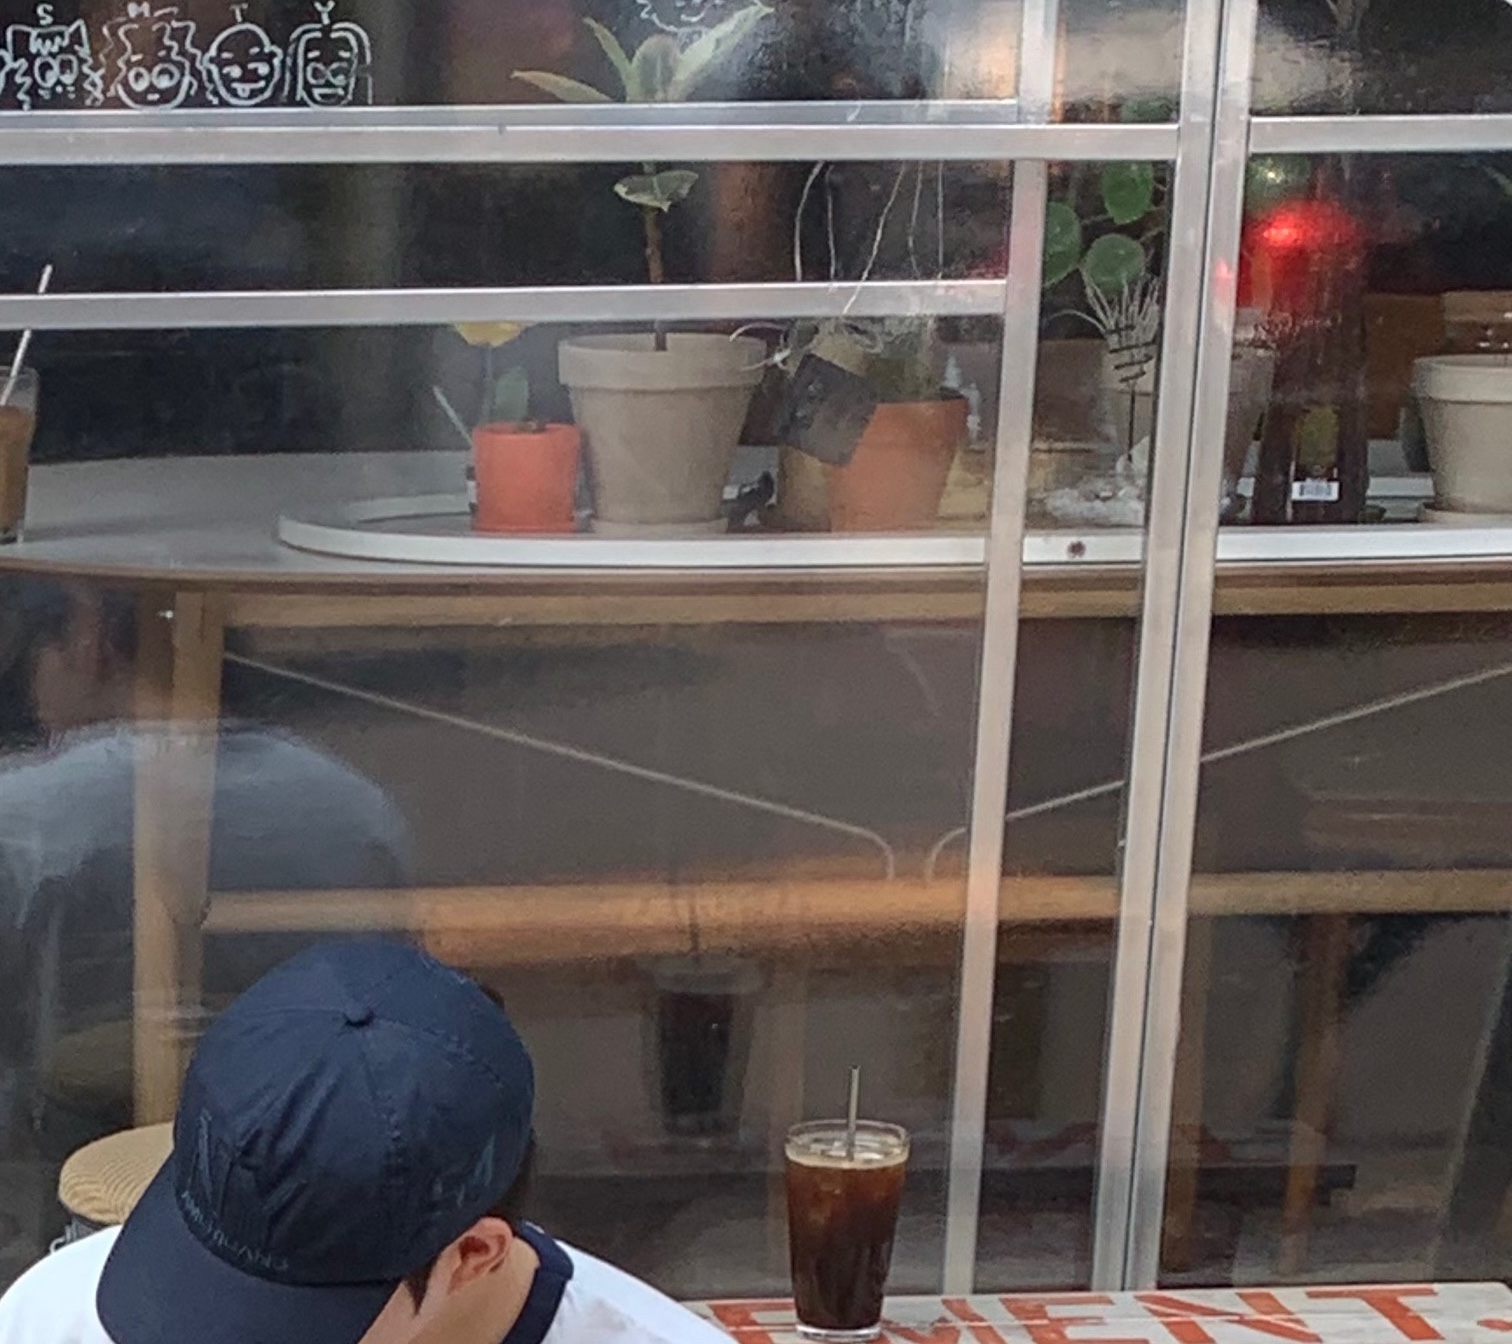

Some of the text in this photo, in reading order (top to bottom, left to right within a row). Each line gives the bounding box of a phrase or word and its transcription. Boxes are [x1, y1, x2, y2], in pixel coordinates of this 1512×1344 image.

[37, 3, 54, 25] S
[232, 3, 249, 23] T
[313, 0, 334, 26] Y
